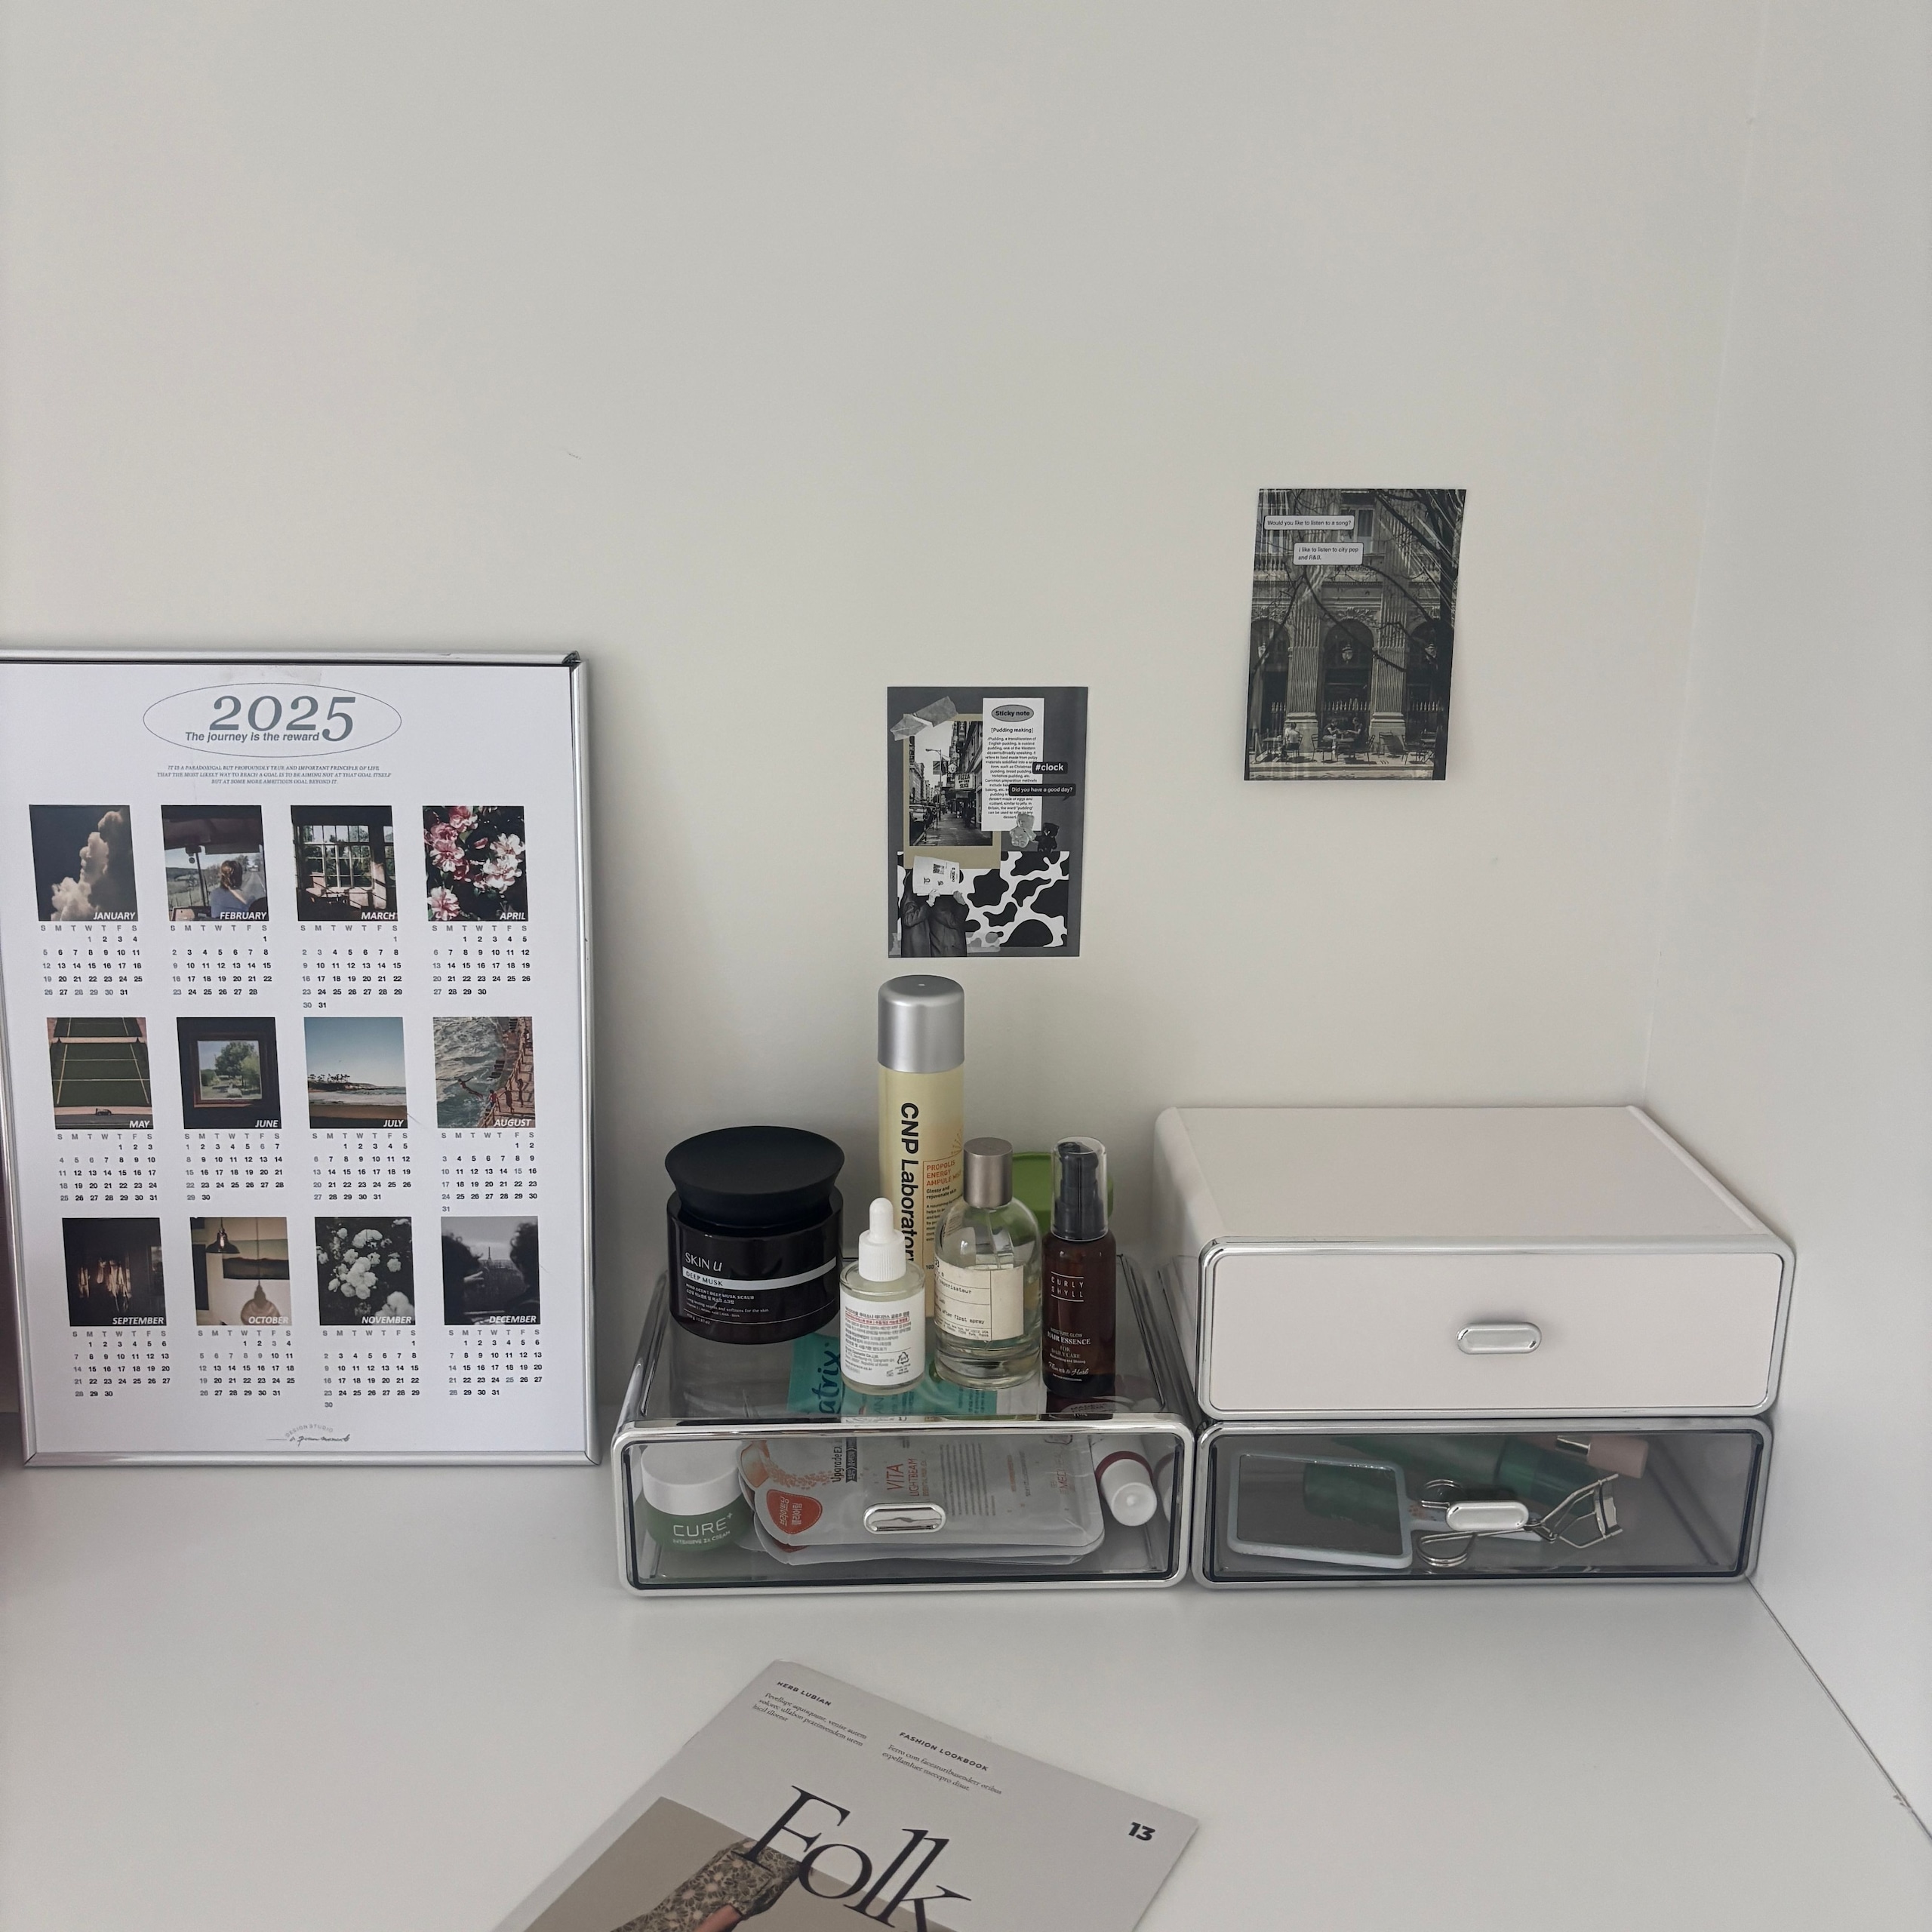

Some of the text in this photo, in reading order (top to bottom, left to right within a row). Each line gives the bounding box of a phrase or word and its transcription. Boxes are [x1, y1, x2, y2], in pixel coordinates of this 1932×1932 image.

[209, 695, 356, 742] 2025
[186, 732, 319, 743] The journey is the reward
[93, 912, 135, 920] JANUARY
[220, 912, 267, 920] FEBRUARY
[927, 1160, 955, 1171] PROPOLIS
[927, 1170, 951, 1178] ENERGY
[927, 1177, 951, 1186] AMPULE
[901, 1103, 919, 1261] CNP Laborator
[685, 1252, 709, 1270] SKIN
[686, 1271, 723, 1286] DEEP MUSK
[1051, 1276, 1084, 1288] CURLY
[1051, 1286, 1083, 1297] SHYLL
[112, 1317, 164, 1325] SEPTEMBER
[1047, 1331, 1091, 1345] HAIR ESSENCE
[812, 1351, 840, 1414] atrix
[309, 1424, 334, 1433] STUDIO
[831, 1454, 844, 1483] Upgrade
[886, 1464, 904, 1490] VITA
[908, 1458, 919, 1496] LIGHTBEAM
[777, 1681, 831, 1706] HERB LUBIAN
[900, 1732, 989, 1771] FASHION LOOKBOOK
[1128, 1822, 1157, 1842] 13
[734, 1785, 972, 1932] Folk
